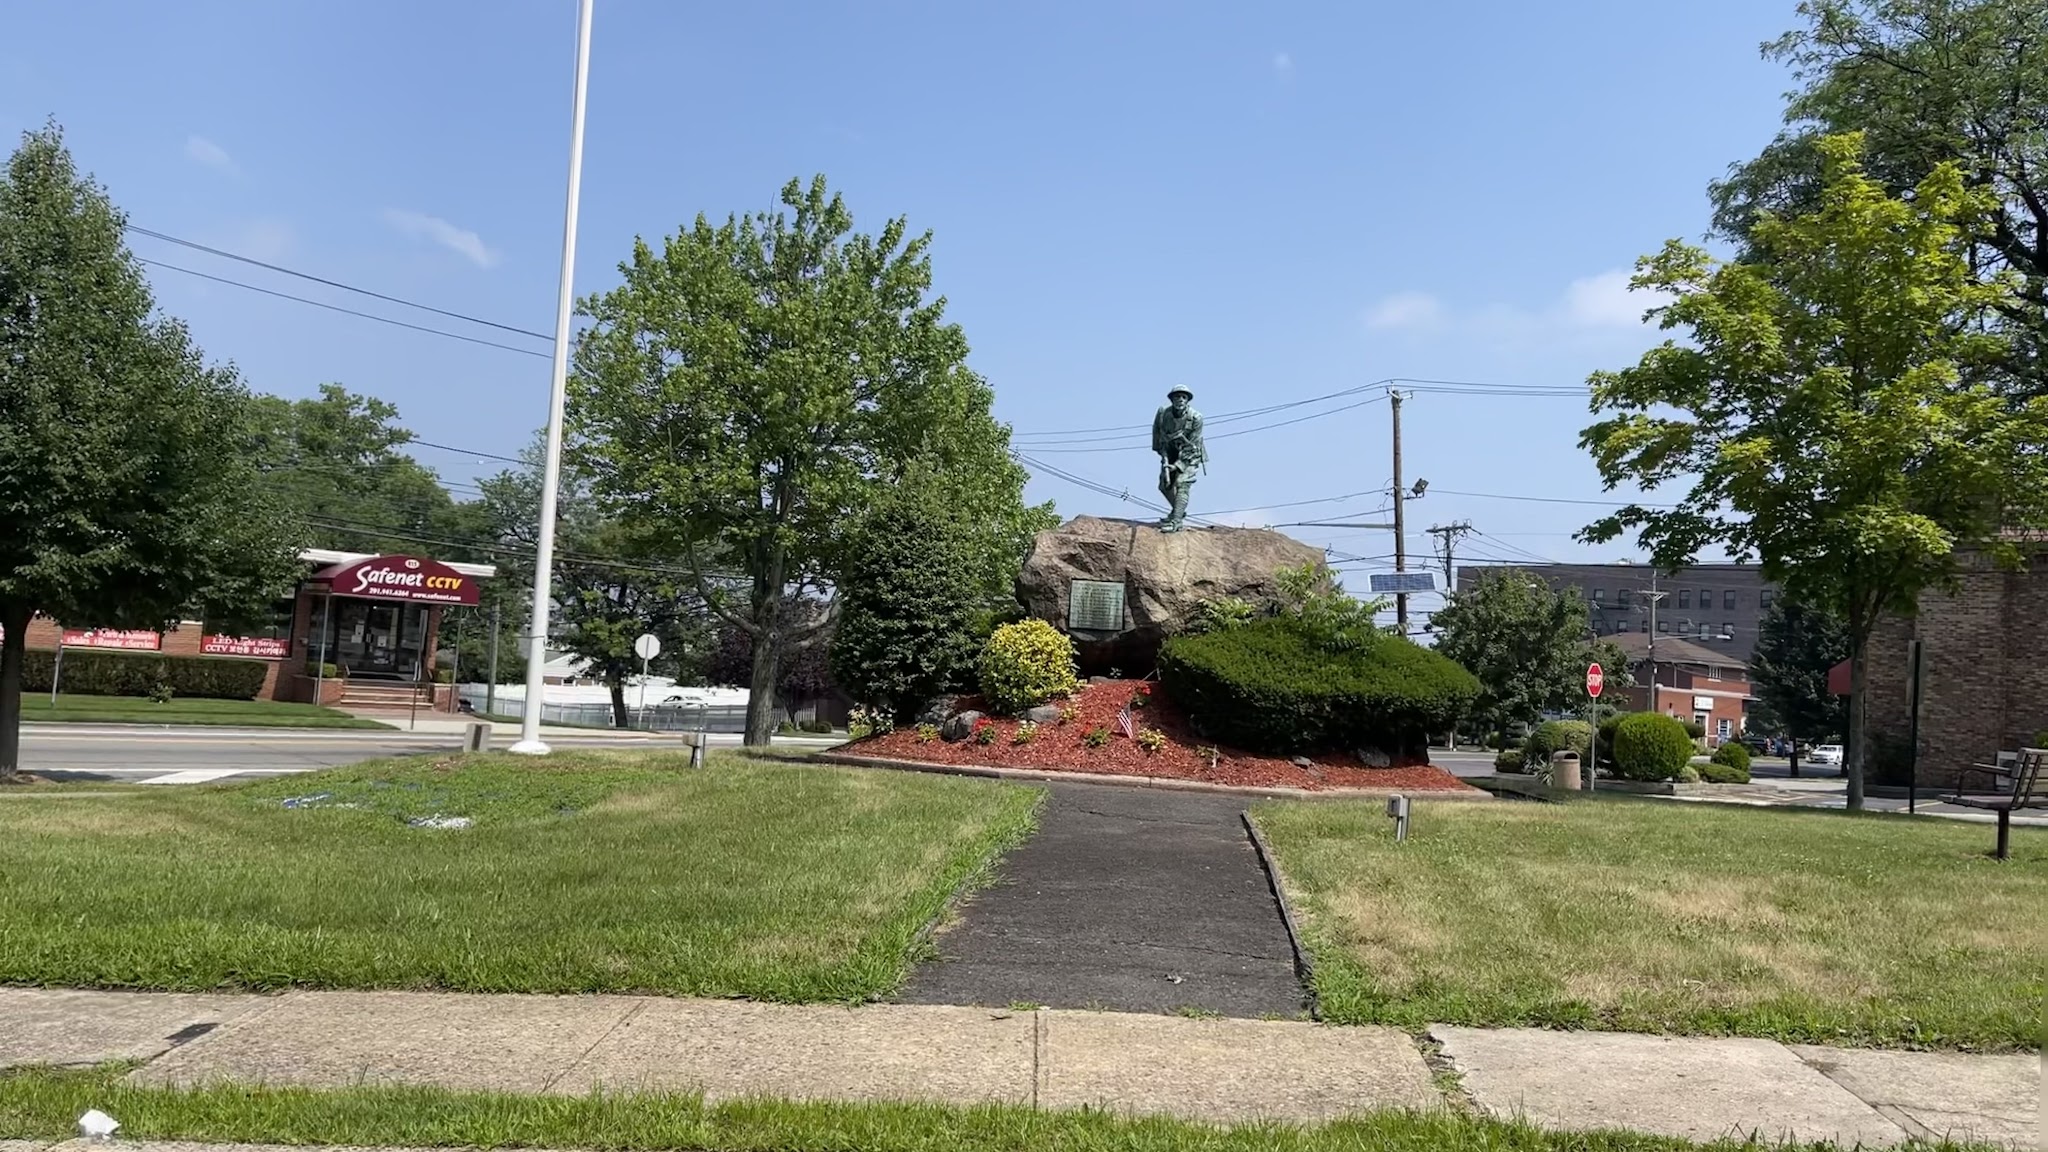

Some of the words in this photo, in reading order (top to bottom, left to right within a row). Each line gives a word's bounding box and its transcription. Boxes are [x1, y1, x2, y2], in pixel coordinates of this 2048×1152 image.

[352, 565, 424, 592] Safenet
[426, 576, 463, 590] CCTV
[212, 637, 233, 645] LED
[205, 644, 228, 652] CCTV
[1588, 673, 1602, 686] STOP
